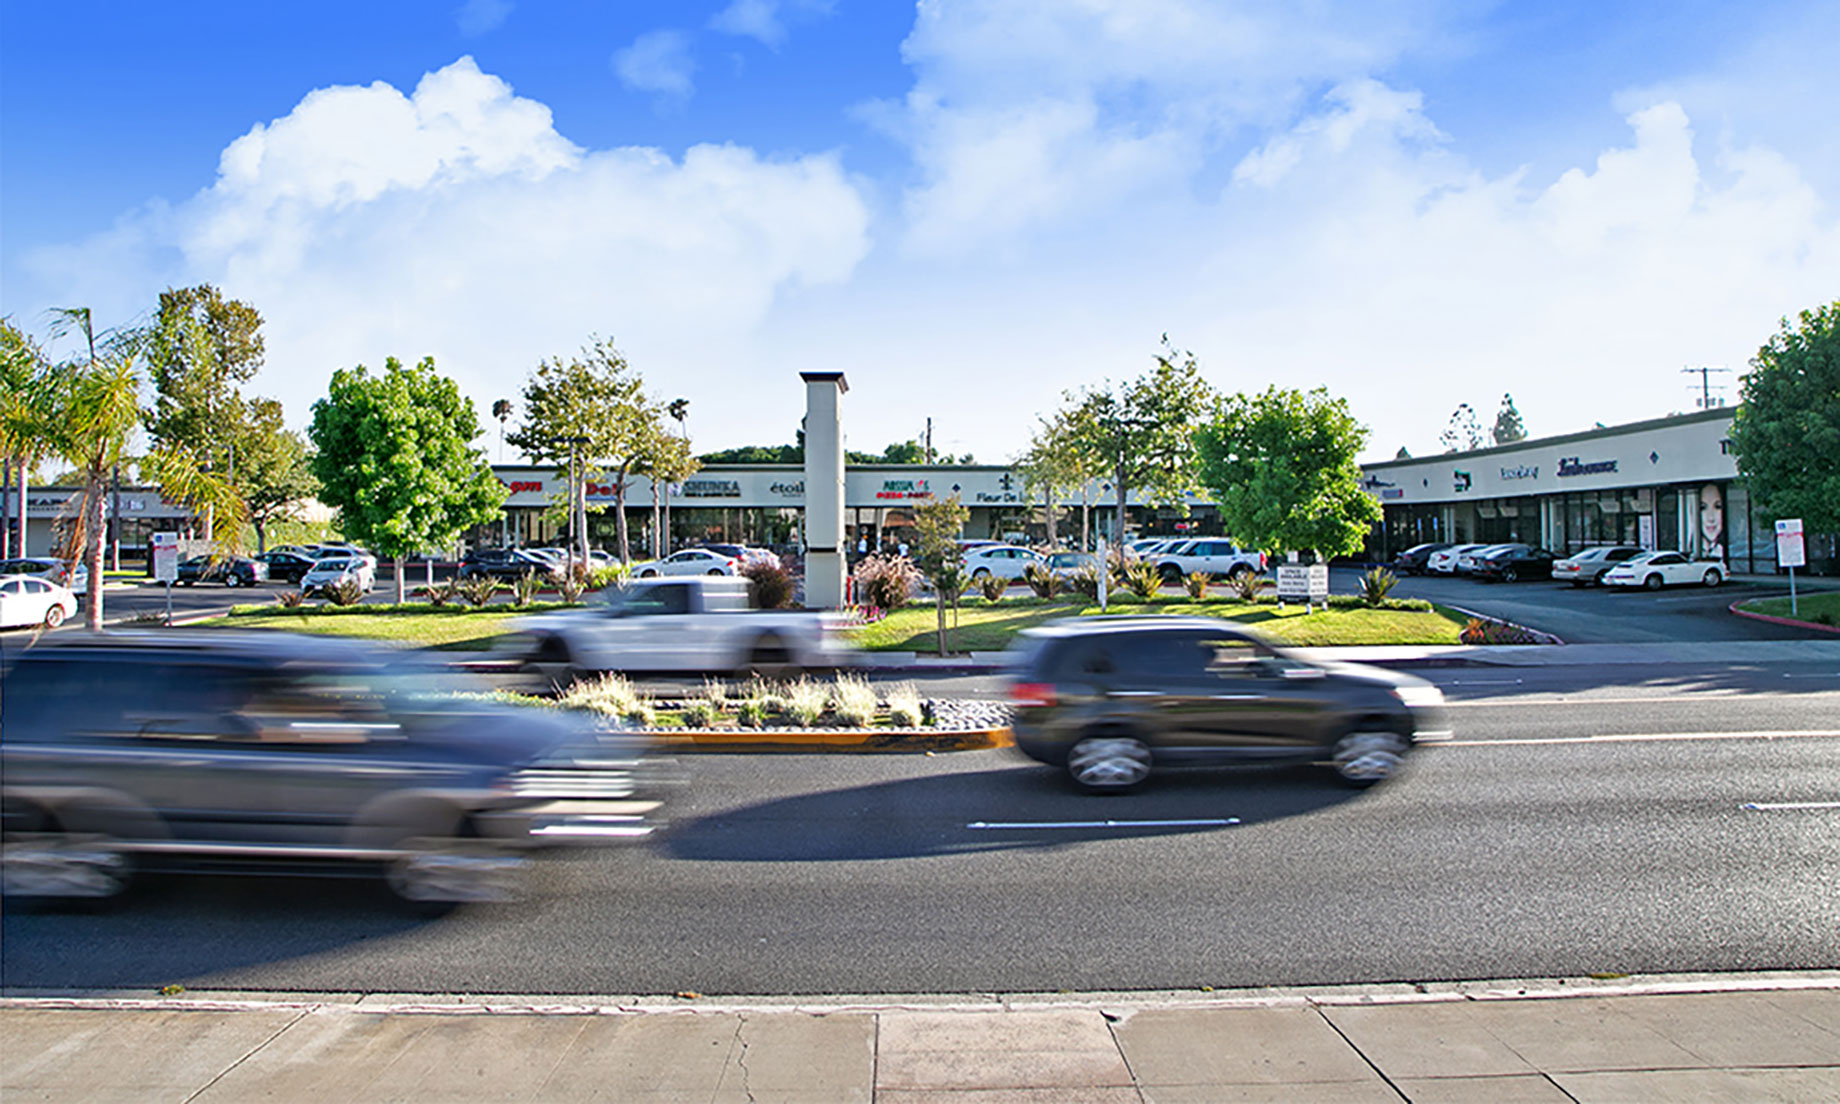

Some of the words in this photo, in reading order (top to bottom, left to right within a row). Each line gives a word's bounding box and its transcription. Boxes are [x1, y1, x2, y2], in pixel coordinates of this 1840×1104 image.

[769, 481, 806, 494] étoil
[976, 493, 1001, 503] Fleur
[1004, 493, 1017, 503] De
